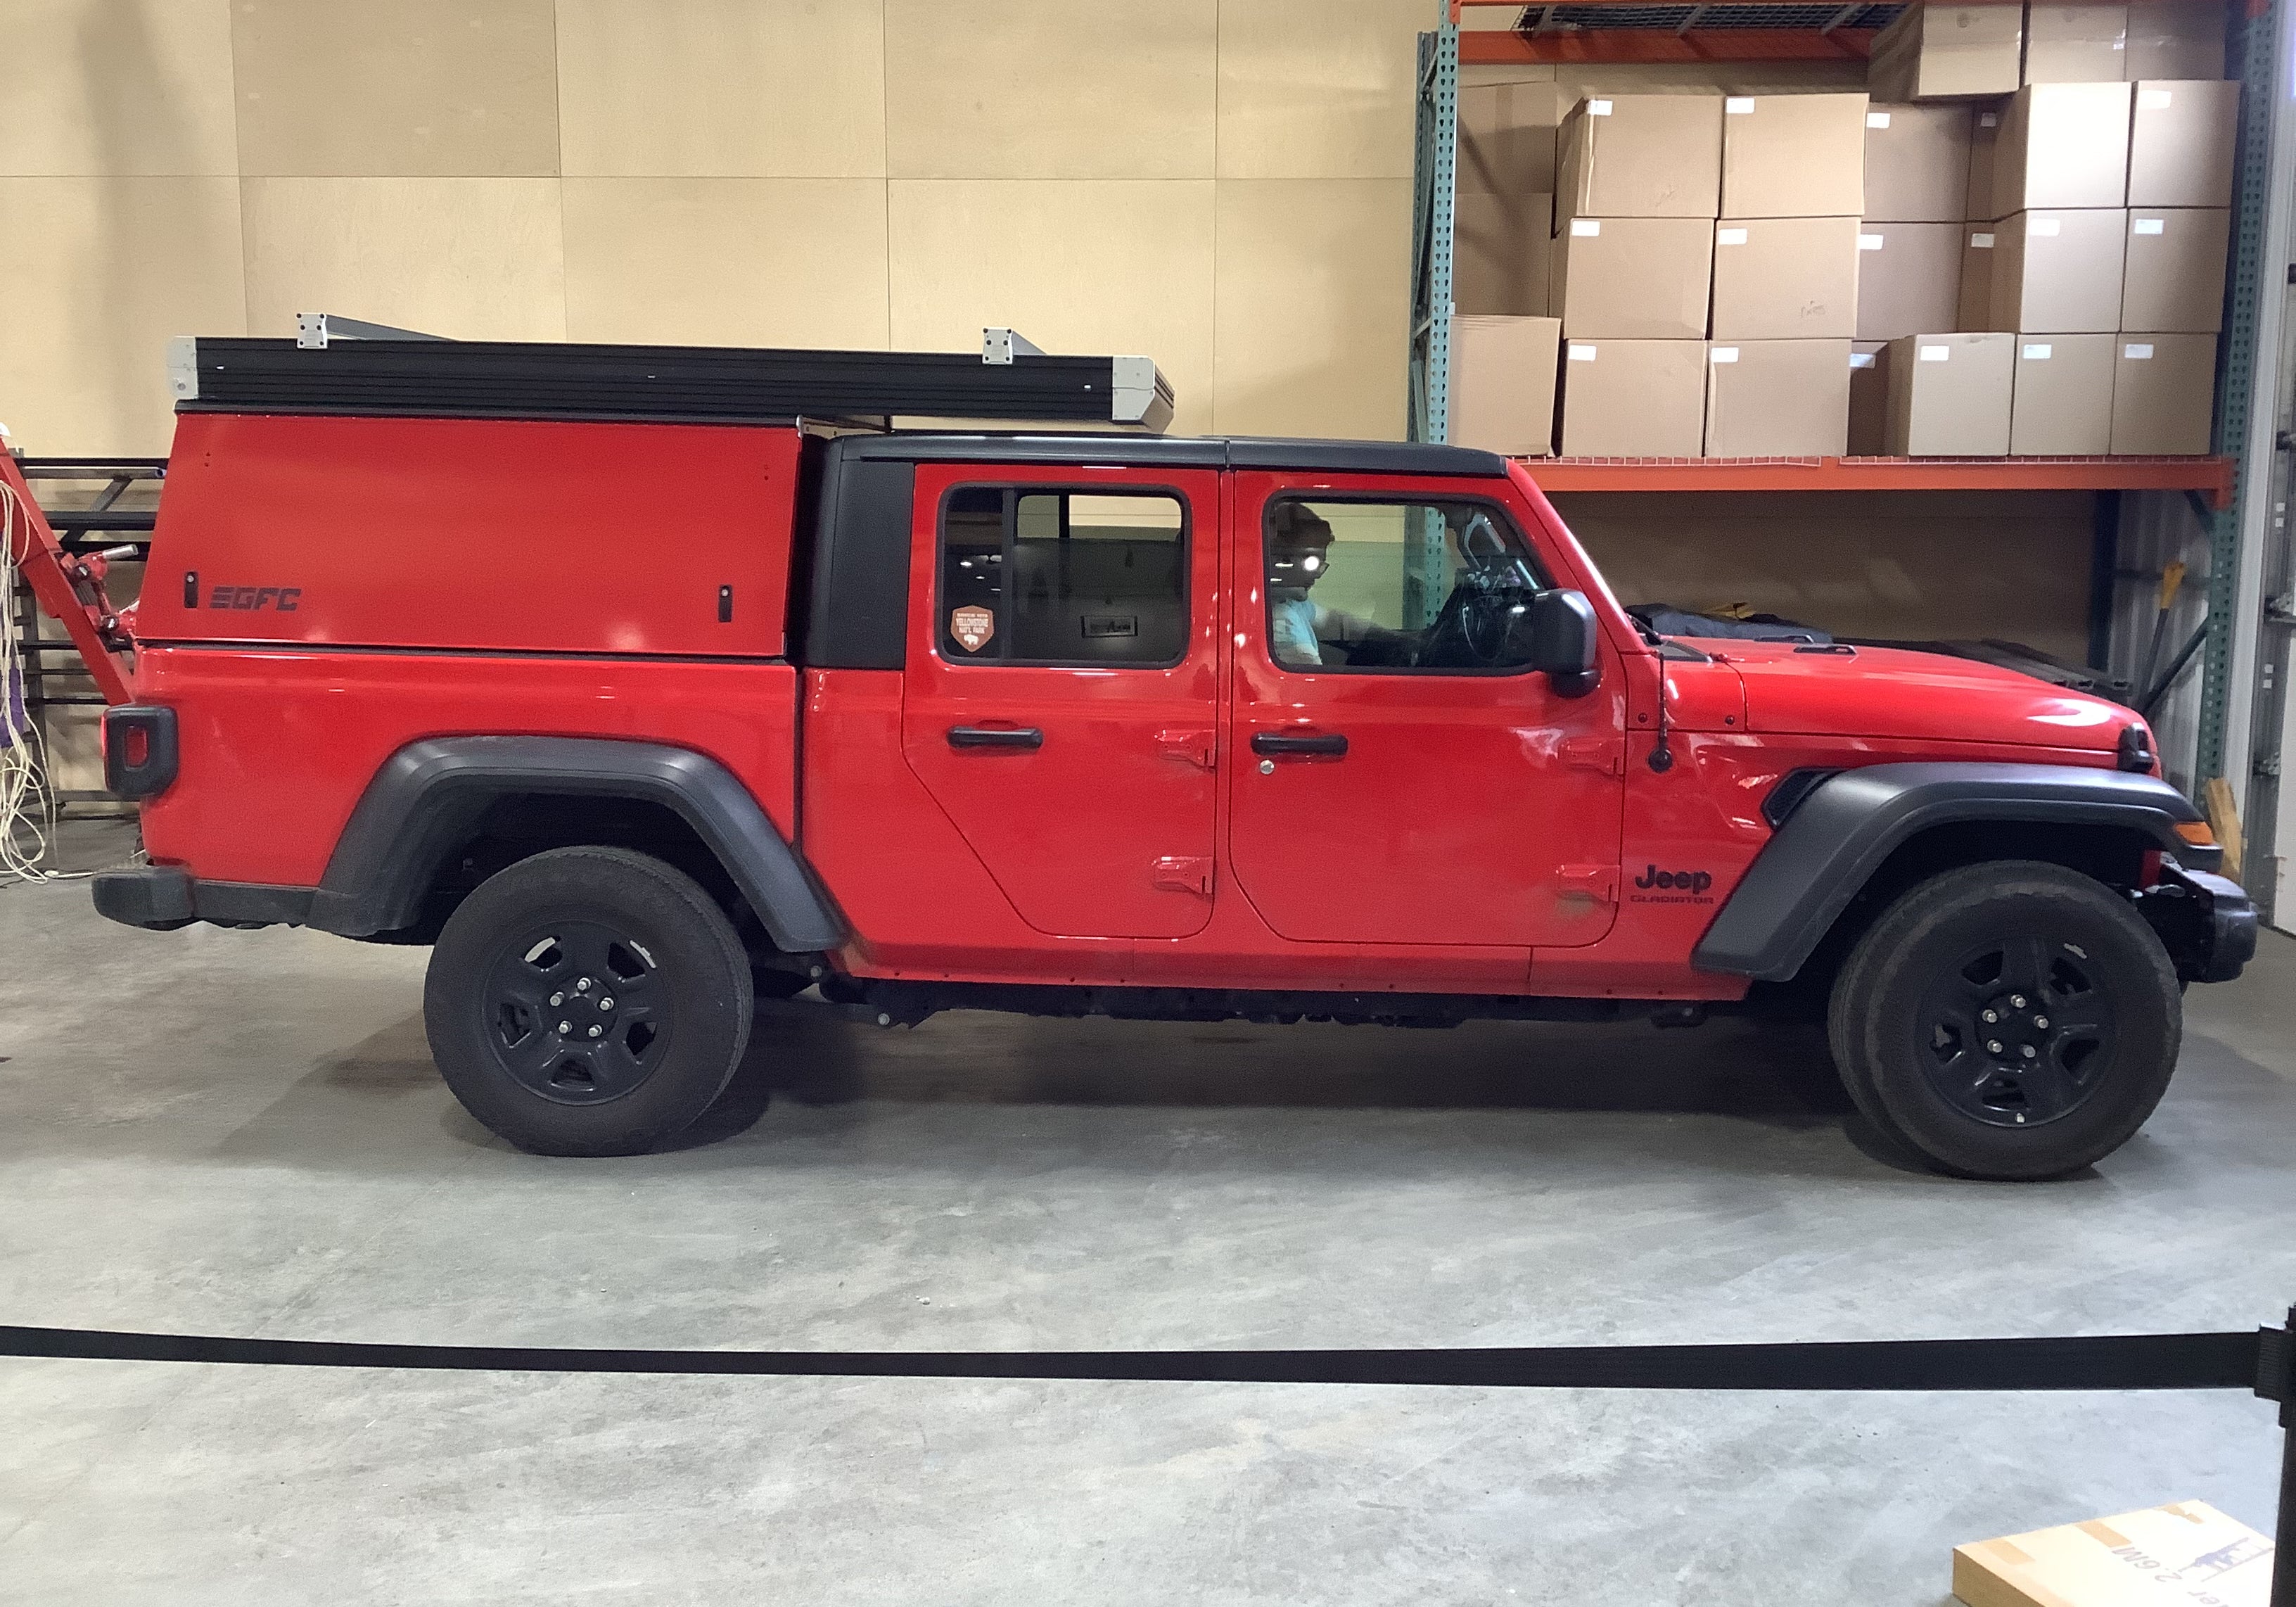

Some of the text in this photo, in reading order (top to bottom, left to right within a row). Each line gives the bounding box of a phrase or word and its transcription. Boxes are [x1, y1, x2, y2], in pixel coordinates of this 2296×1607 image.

[956, 618, 988, 628] YELLOWSTONE
[1635, 864, 1712, 894] Jeep
[1630, 895, 1714, 904] GLADIATOR
